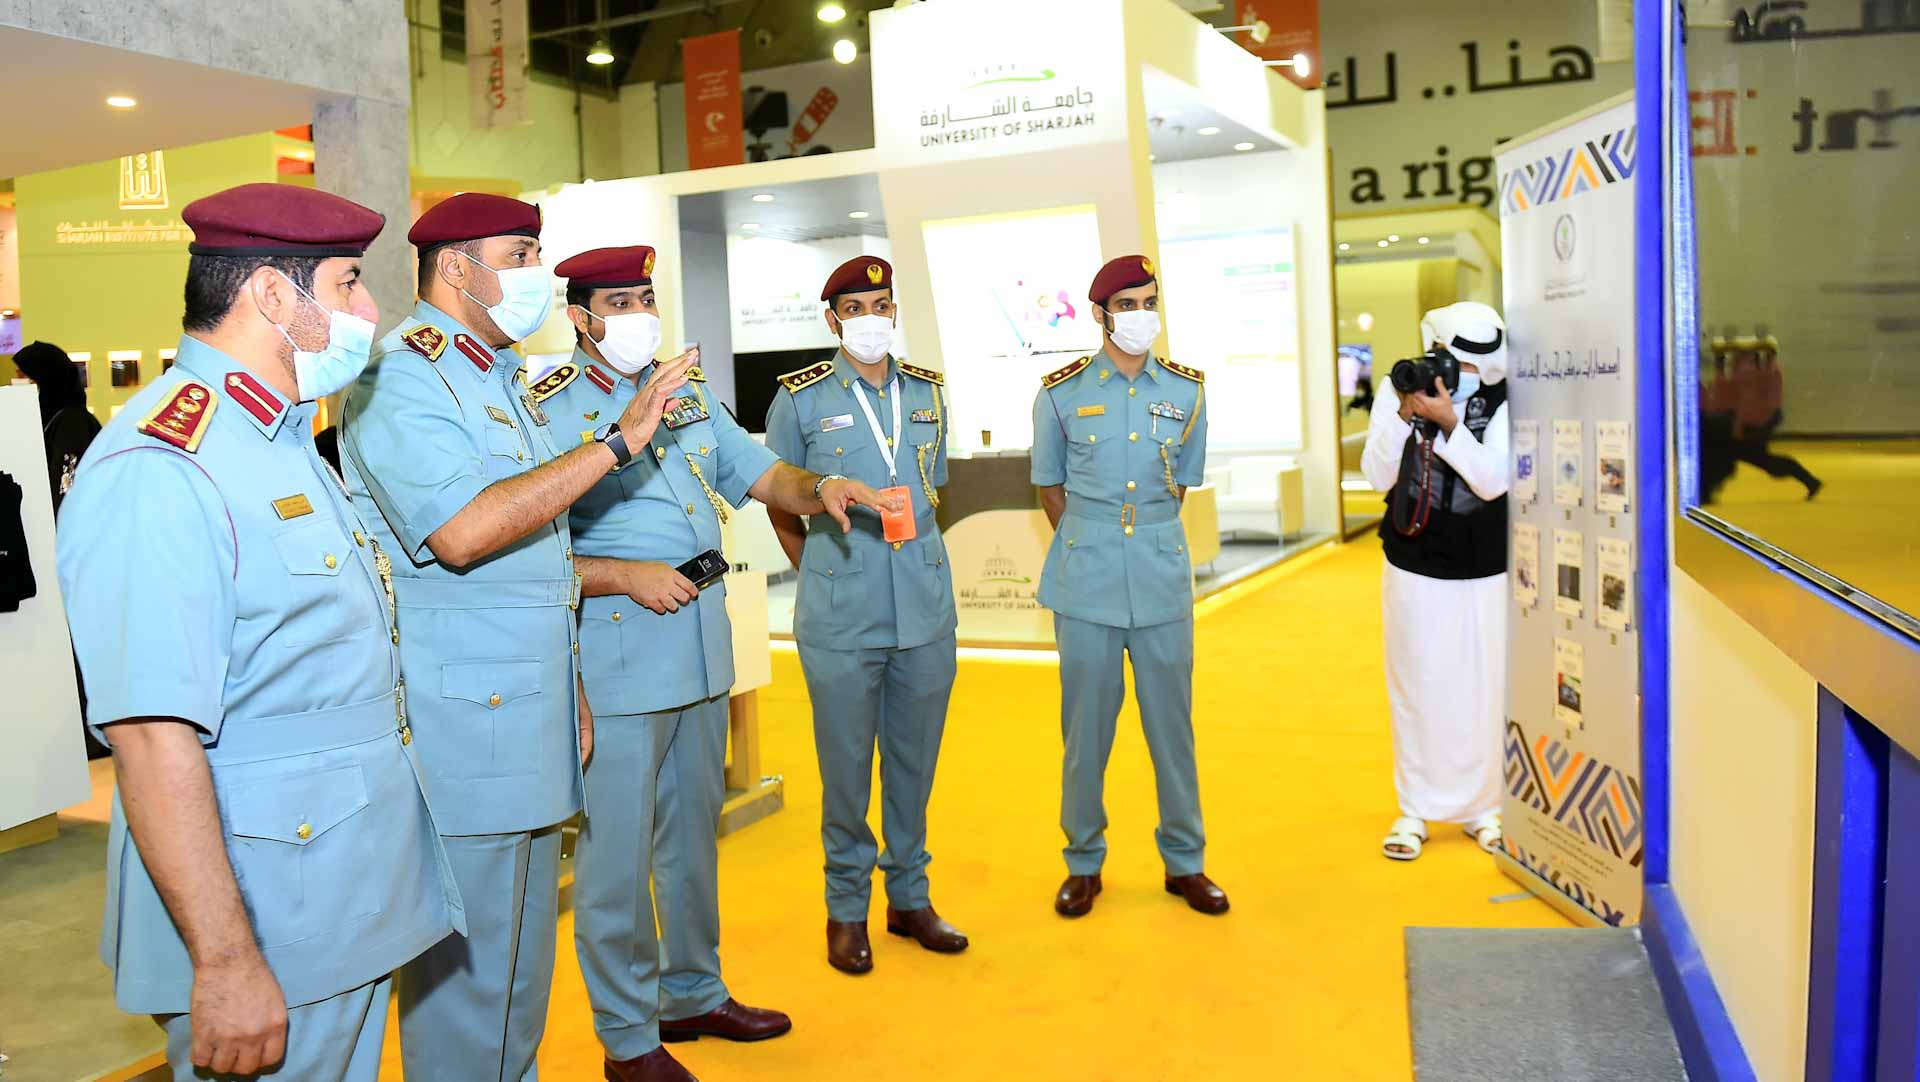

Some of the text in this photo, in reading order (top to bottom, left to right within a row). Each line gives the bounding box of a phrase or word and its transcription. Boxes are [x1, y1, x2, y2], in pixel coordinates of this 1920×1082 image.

[920, 86, 1093, 128] جامعة الشارقة
[920, 113, 1095, 147] UNIVERSITY OF SHARJAH
[1351, 138, 1512, 208] a rig
